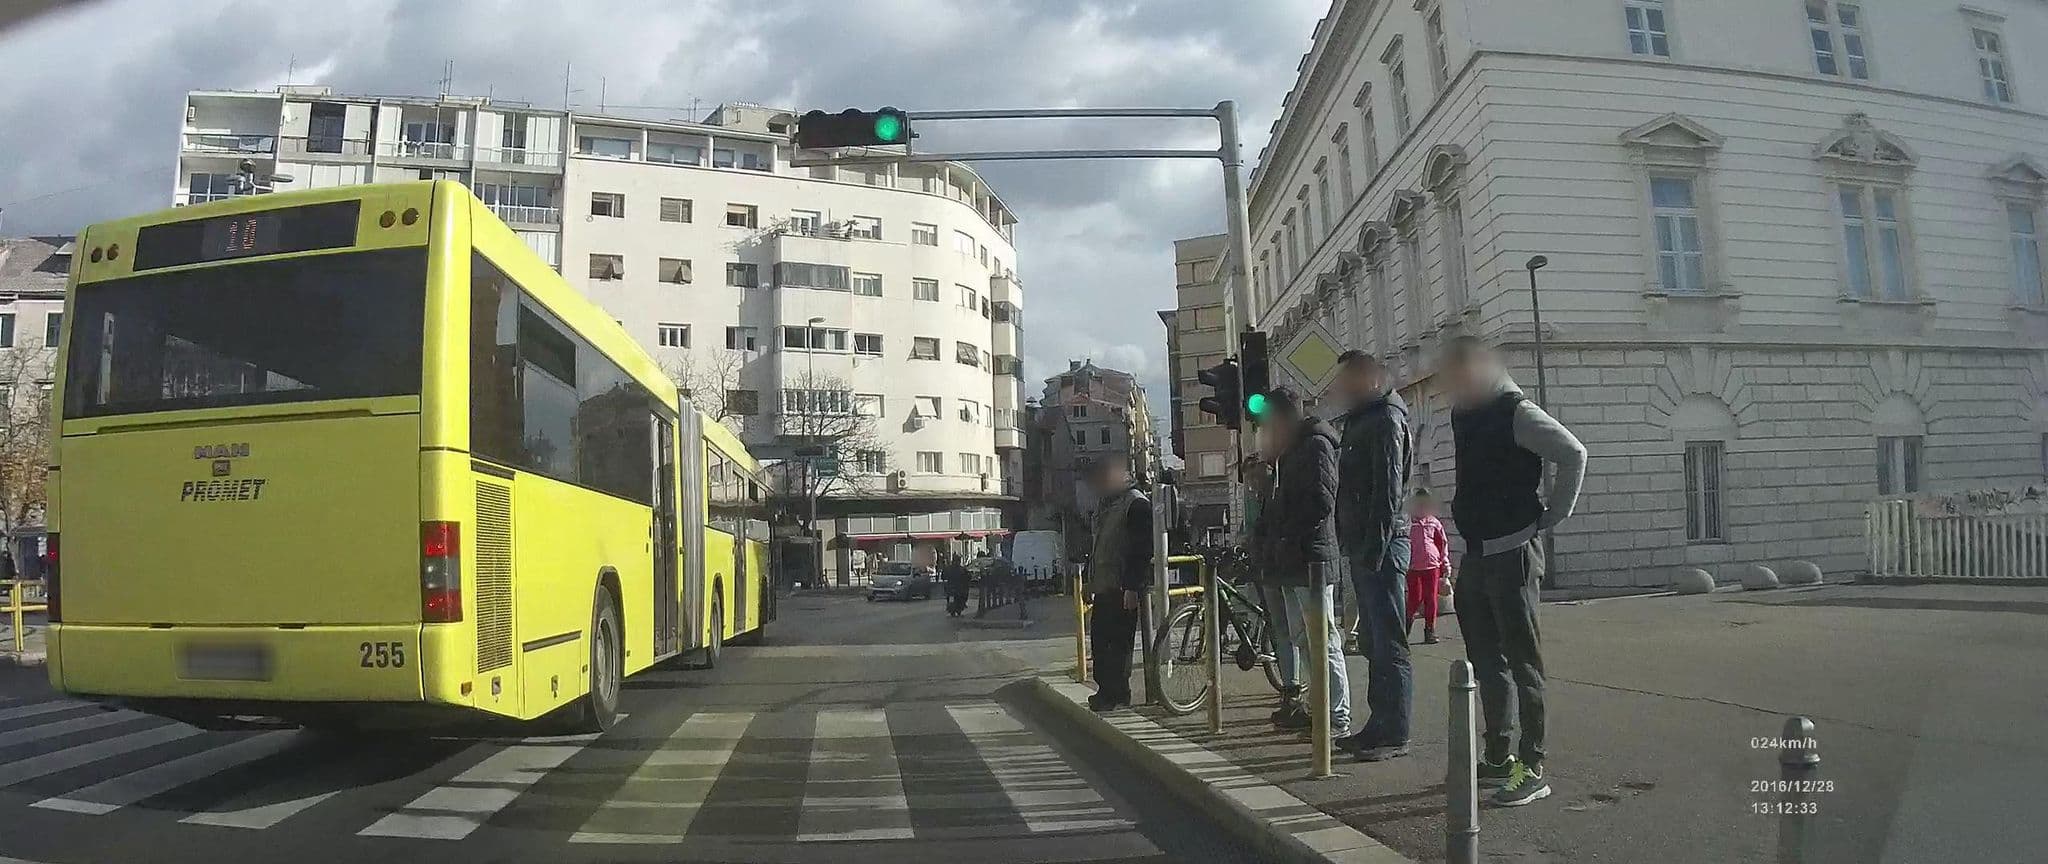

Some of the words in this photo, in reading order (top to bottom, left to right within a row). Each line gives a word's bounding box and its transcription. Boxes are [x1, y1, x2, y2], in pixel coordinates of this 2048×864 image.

[194, 443, 249, 459] MAN
[181, 479, 266, 502] PROMET
[360, 641, 405, 668] 255
